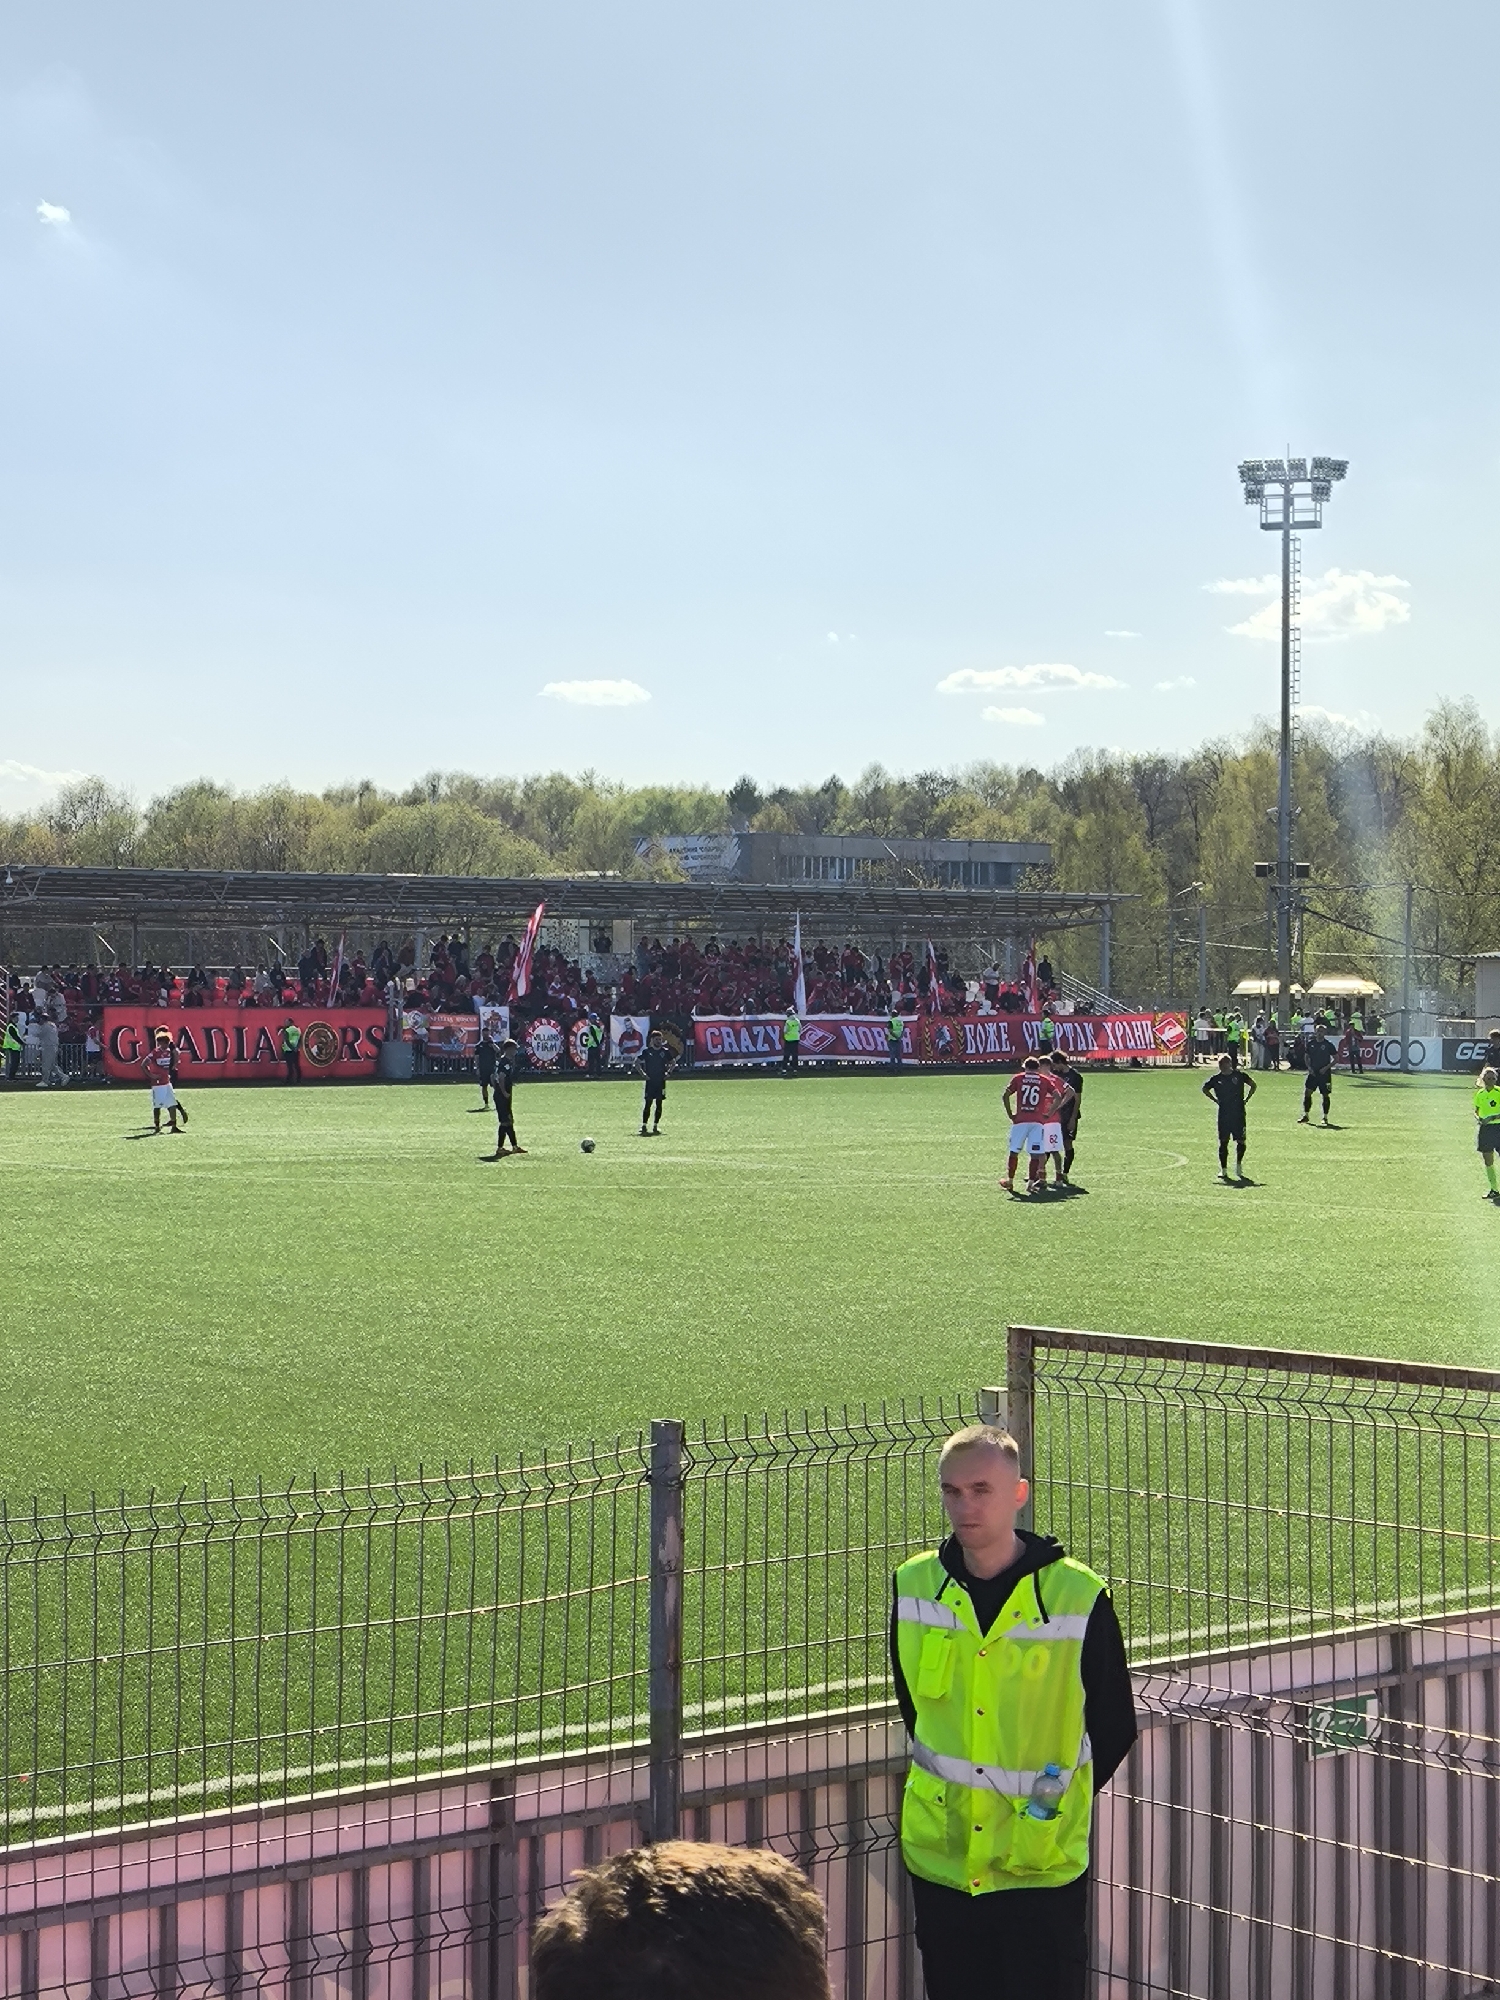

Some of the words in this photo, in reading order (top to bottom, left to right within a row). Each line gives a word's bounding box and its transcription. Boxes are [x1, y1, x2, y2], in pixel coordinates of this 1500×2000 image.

[537, 1041, 557, 1051] FIRM
[705, 1025, 783, 1054] CRAZY
[965, 1021, 1016, 1054] БОЖЕ,
[1022, 1020, 1098, 1052] СПРТАК
[1104, 1019, 1156, 1051] ХРАНИ
[1374, 1038, 1427, 1067] 100
[1456, 1041, 1493, 1060] GE
[1021, 1084, 1040, 1106] 76
